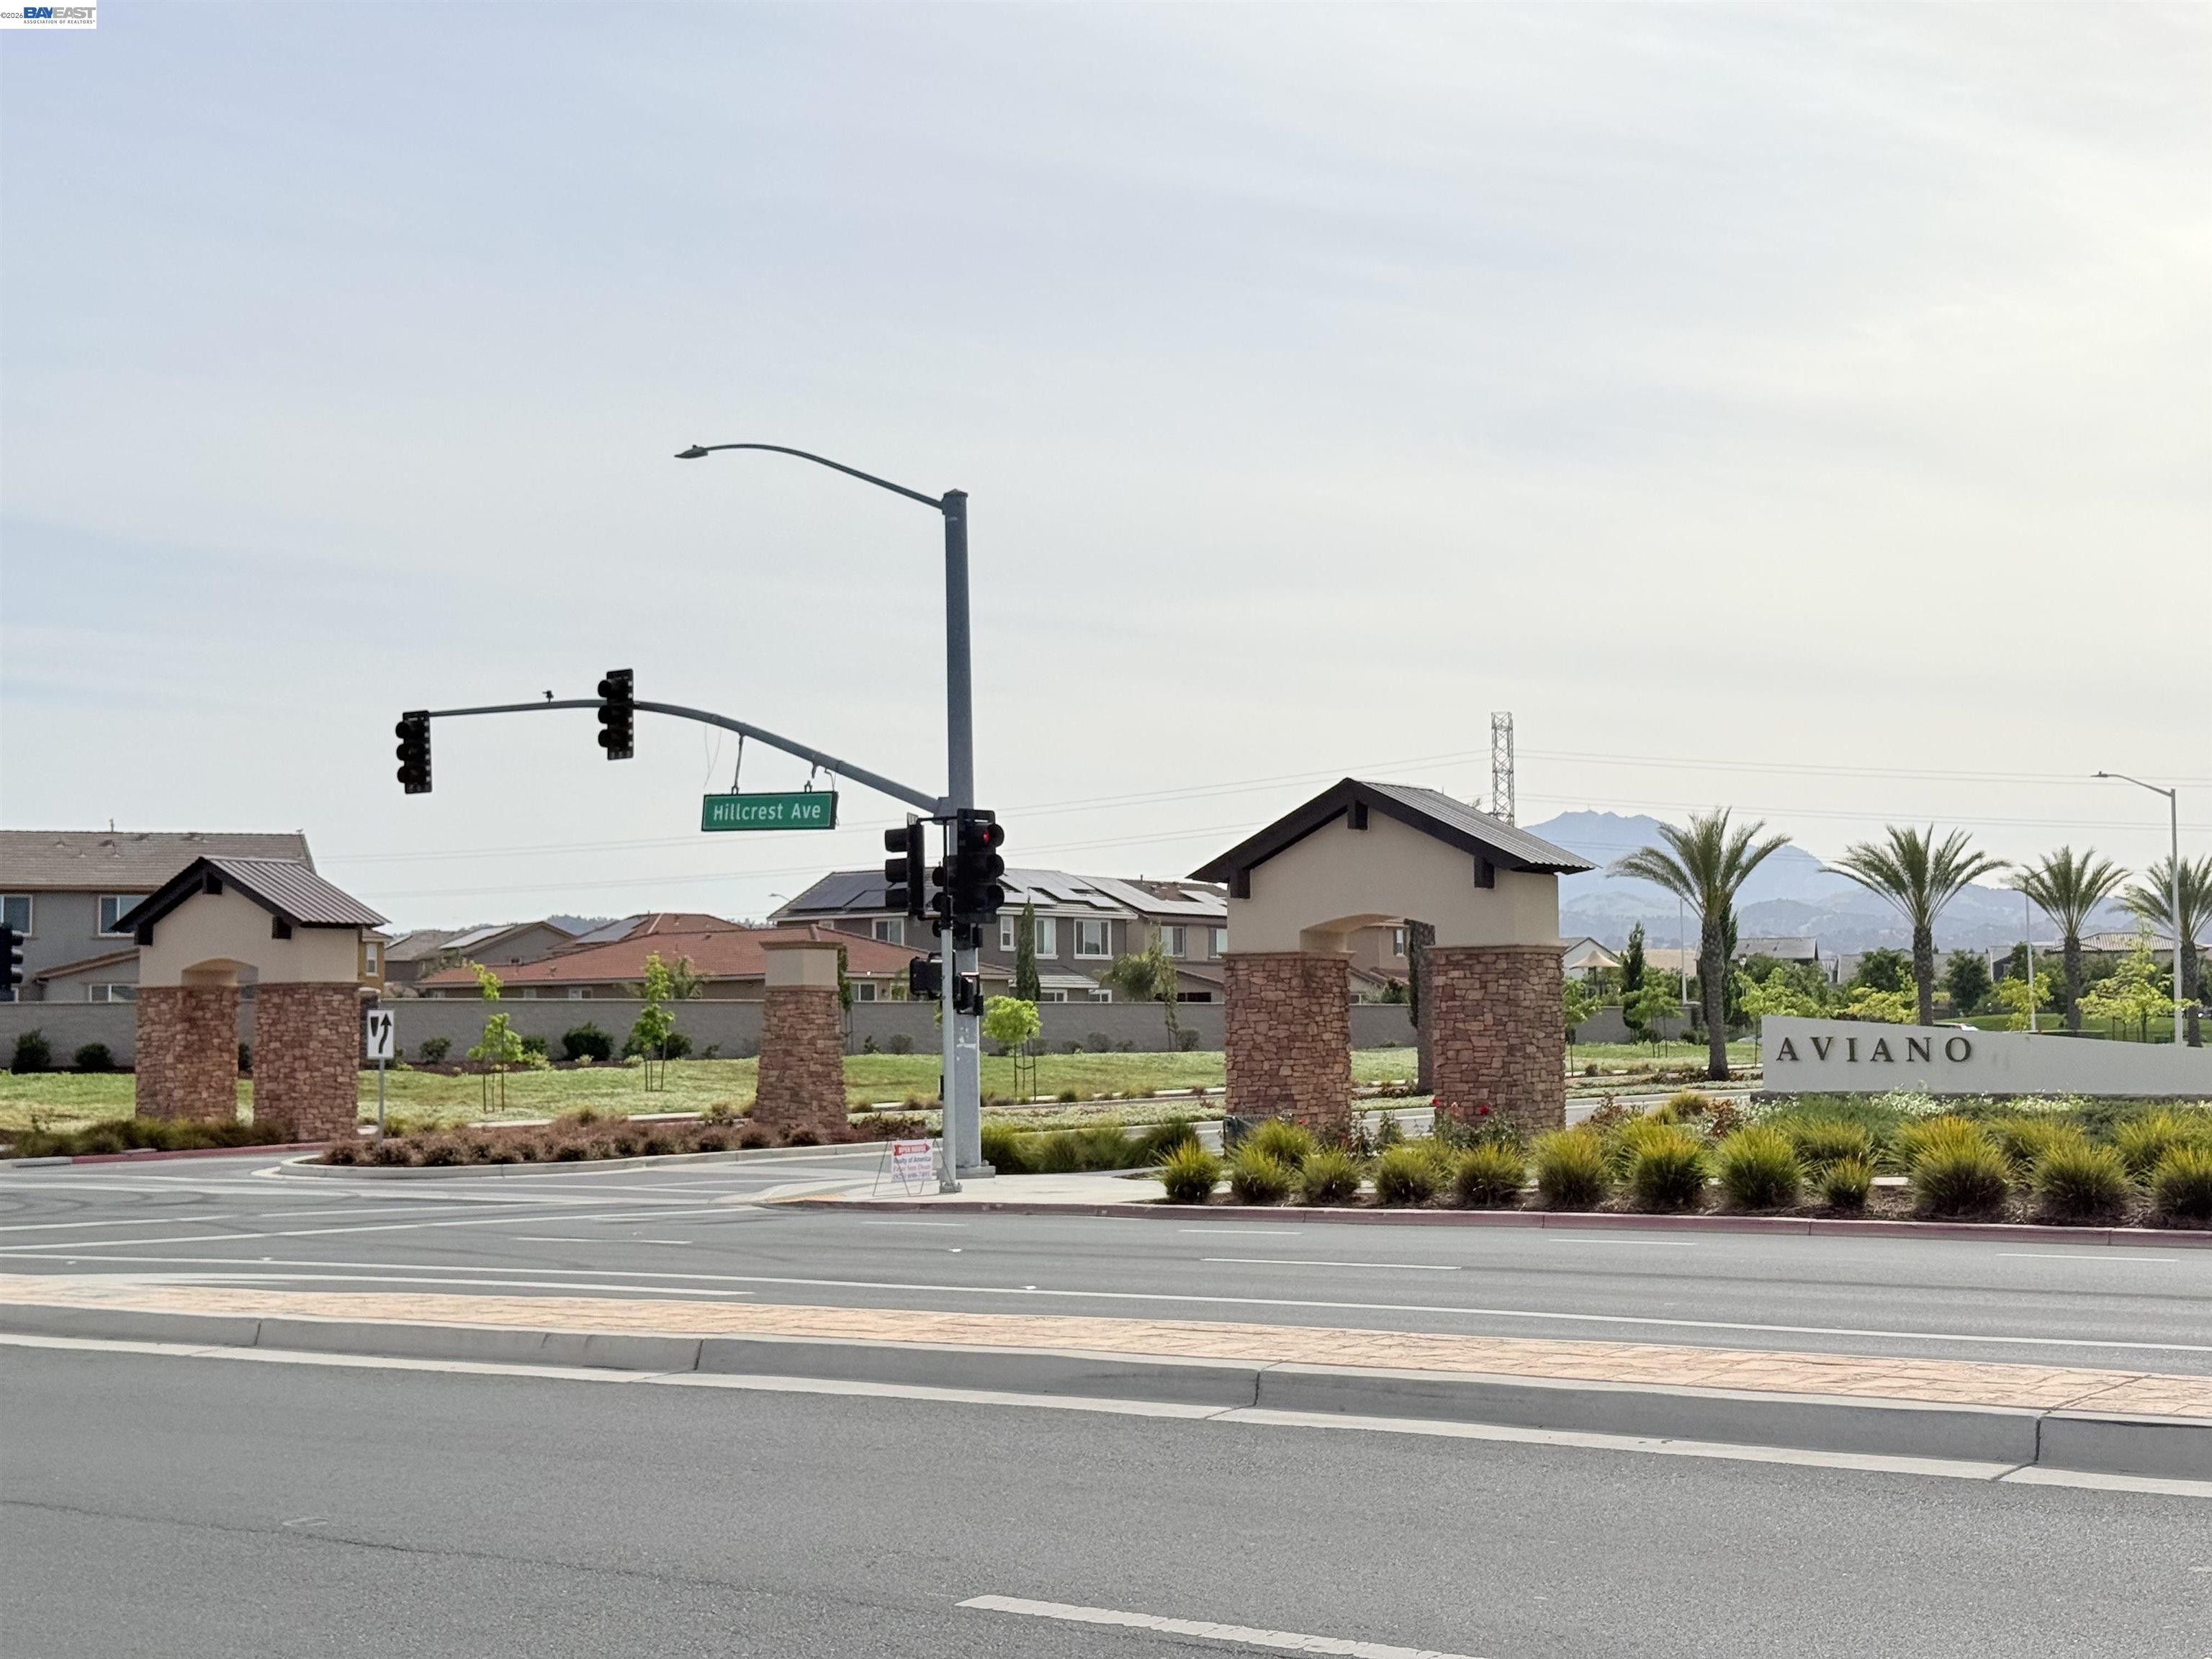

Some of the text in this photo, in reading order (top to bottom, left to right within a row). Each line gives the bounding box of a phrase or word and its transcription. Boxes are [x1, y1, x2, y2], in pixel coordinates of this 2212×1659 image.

[714, 802, 821, 821] Hillcrest Ave
[1776, 1037, 1972, 1062] AVIANO
